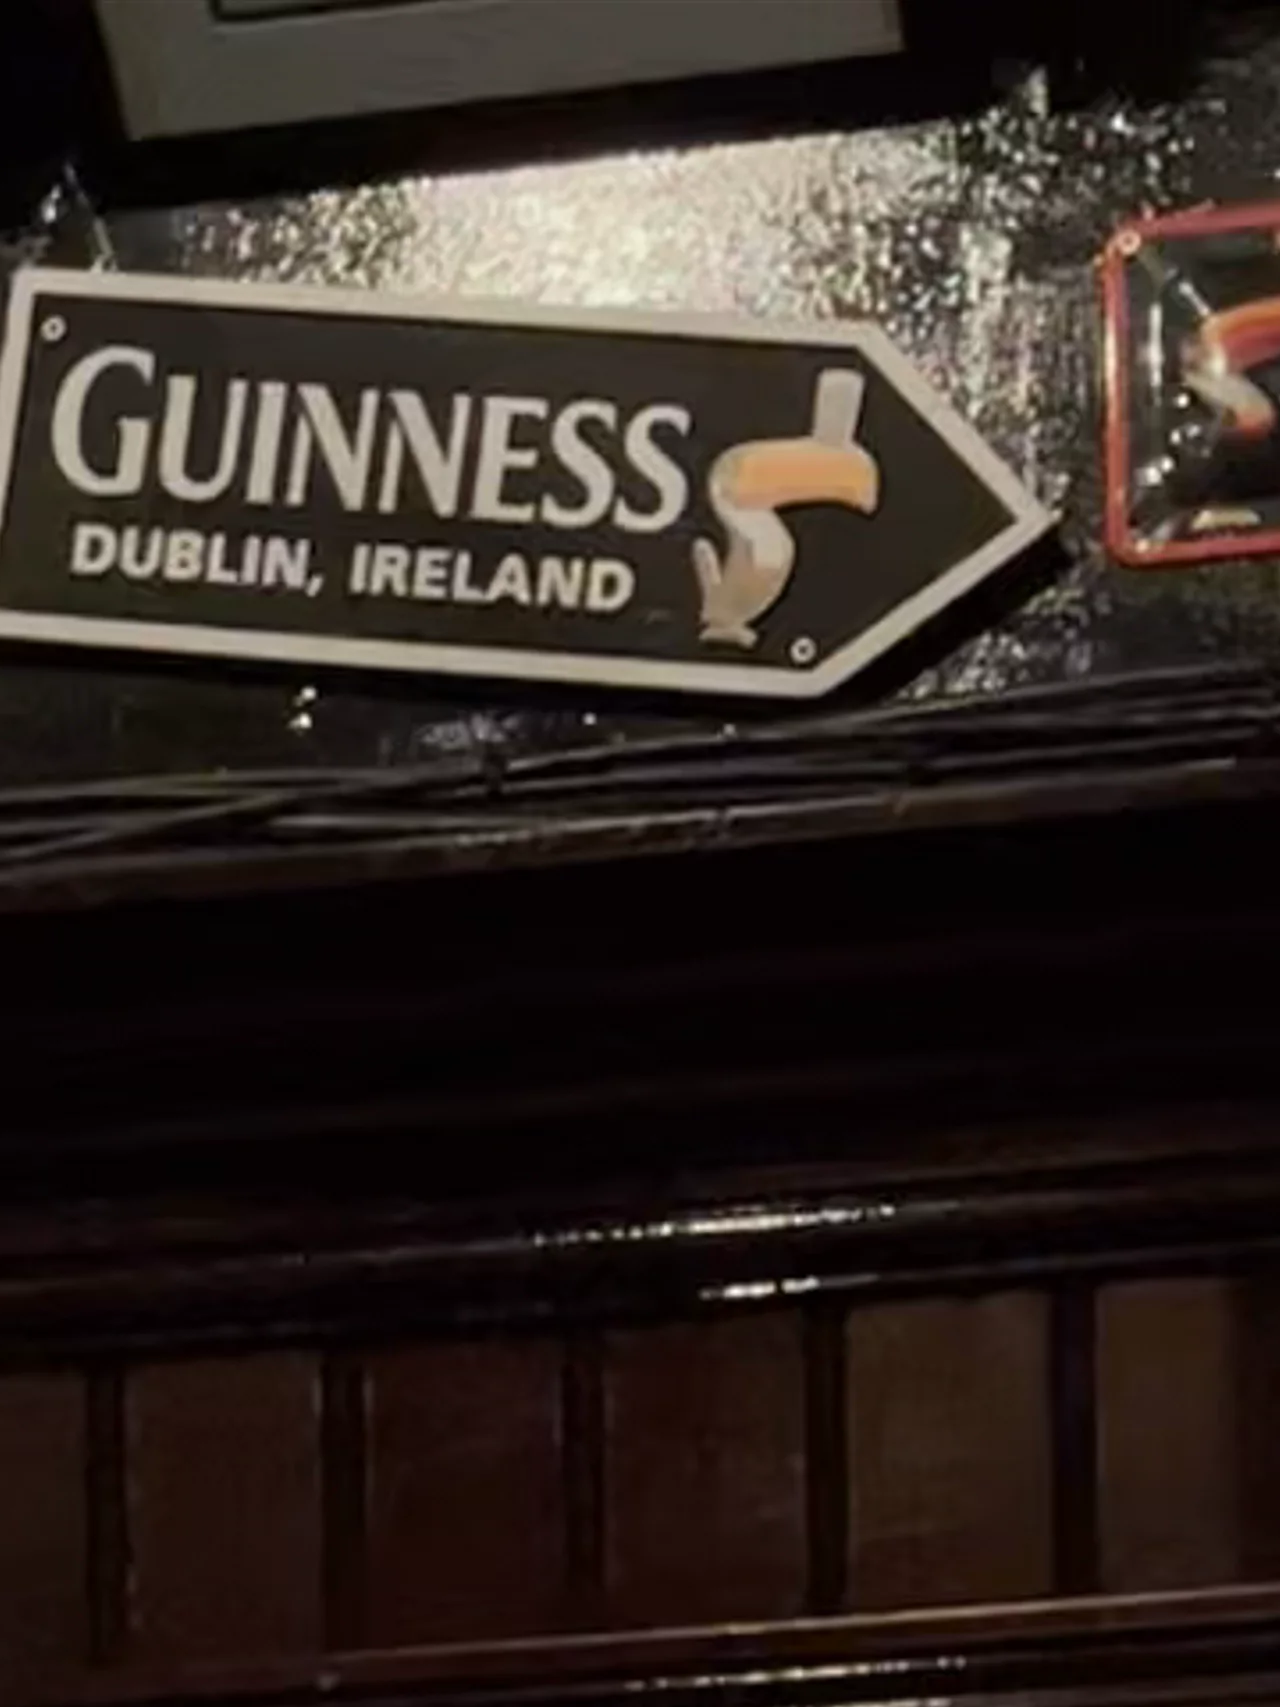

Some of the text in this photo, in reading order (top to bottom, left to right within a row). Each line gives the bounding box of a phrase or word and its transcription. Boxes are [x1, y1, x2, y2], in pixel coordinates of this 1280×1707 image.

[51, 344, 691, 534] GUINNESS
[71, 523, 635, 613] DUBLIN, IRELAND
